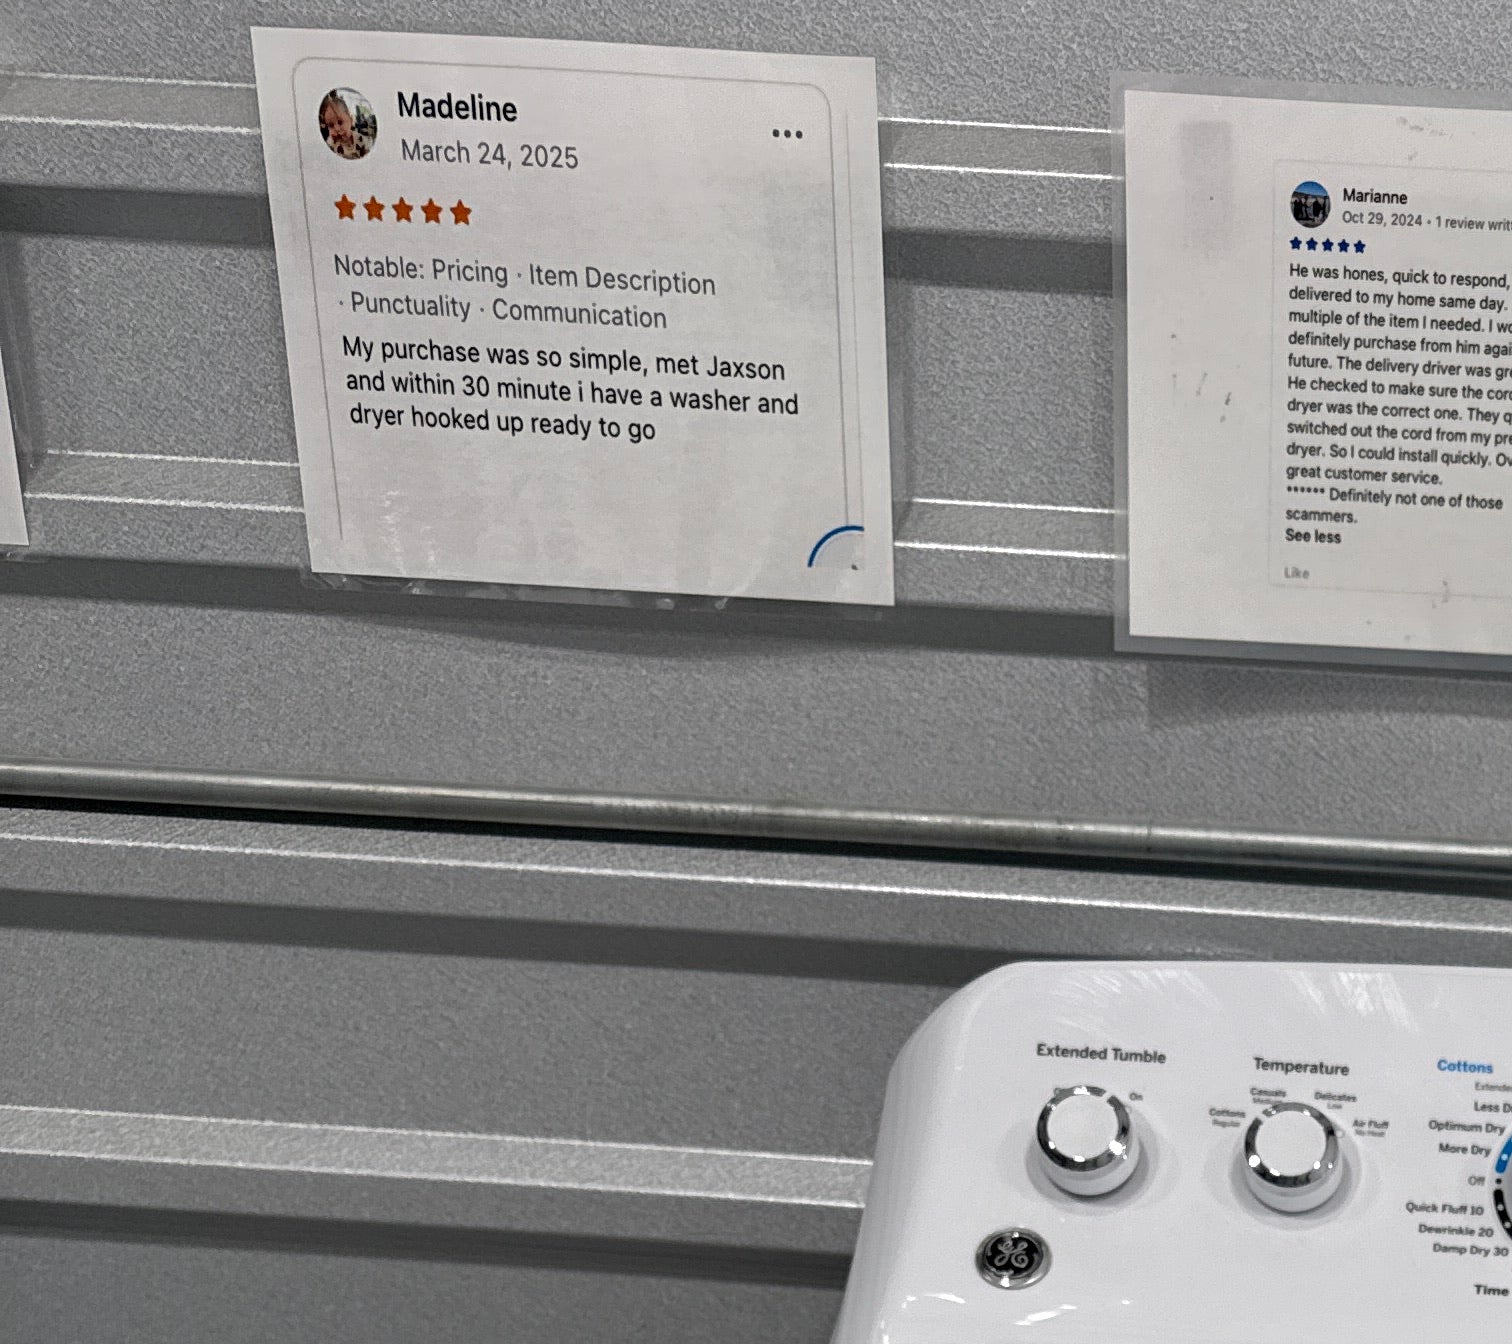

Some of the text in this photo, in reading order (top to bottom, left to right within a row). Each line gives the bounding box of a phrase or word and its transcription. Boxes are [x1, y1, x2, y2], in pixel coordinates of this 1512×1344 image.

[397, 91, 516, 121] Madeline
[401, 138, 578, 170] March 24, 2025
[1343, 188, 1407, 204] Marianne
[1342, 210, 1363, 223] Oct
[1367, 212, 1386, 226] 29,
[1391, 213, 1422, 226] 2024
[1436, 215, 1440, 227] 1
[1445, 217, 1484, 229] review
[334, 254, 715, 296] Notable: Pricing Item Description
[1290, 263, 1308, 277] He
[1312, 267, 1338, 279] was
[1343, 265, 1387, 283] hones,
[1392, 269, 1428, 284] quick
[1433, 272, 1446, 284] to
[1451, 274, 1509, 290] respond,
[1289, 286, 1351, 302] delivered
[1355, 290, 1369, 303] to
[1373, 293, 1393, 307] my
[1398, 291, 1435, 306] home
[1439, 296, 1475, 308] same
[1479, 296, 1507, 313] day.
[351, 291, 666, 328] Punctuality Communication
[1289, 309, 1342, 326] multiple
[1346, 311, 1360, 325] of
[1363, 312, 1385, 326] the
[1389, 313, 1418, 328] item
[1423, 315, 1426, 328] I
[1430, 317, 1484, 331] needed.
[1489, 319, 1492, 332] I
[1288, 331, 1350, 350] definitely
[1354, 336, 1416, 351] purchase
[1420, 337, 1451, 352] from
[1456, 339, 1480, 354] him
[343, 335, 784, 379] My purchase was so simple, met Jaxson
[347, 370, 797, 414] and within 30 minute i have a washer and
[350, 402, 654, 443] dryer hooked up ready to go
[1285, 528, 1341, 543] See less
[1284, 567, 1309, 578] Like
[1036, 1043, 1165, 1063] Extended Tumble
[1253, 1057, 1349, 1075] Temperature
[1437, 1059, 1493, 1073] Cottons
[1250, 1087, 1286, 1097] Casuals
[1314, 1091, 1356, 1102] Delicates
[1209, 1108, 1245, 1118] Cottons
[1474, 1101, 1499, 1112] Less
[1428, 1119, 1505, 1135] Optimum Dry
[1439, 1143, 1491, 1157] More Dry
[1468, 1175, 1485, 1185] Off
[1405, 1201, 1484, 1215] Quick Fluff 10
[1418, 1223, 1494, 1237] Dewrinkle 20
[1433, 1242, 1509, 1257] Damp Dry 30
[1474, 1284, 1509, 1296] Time
